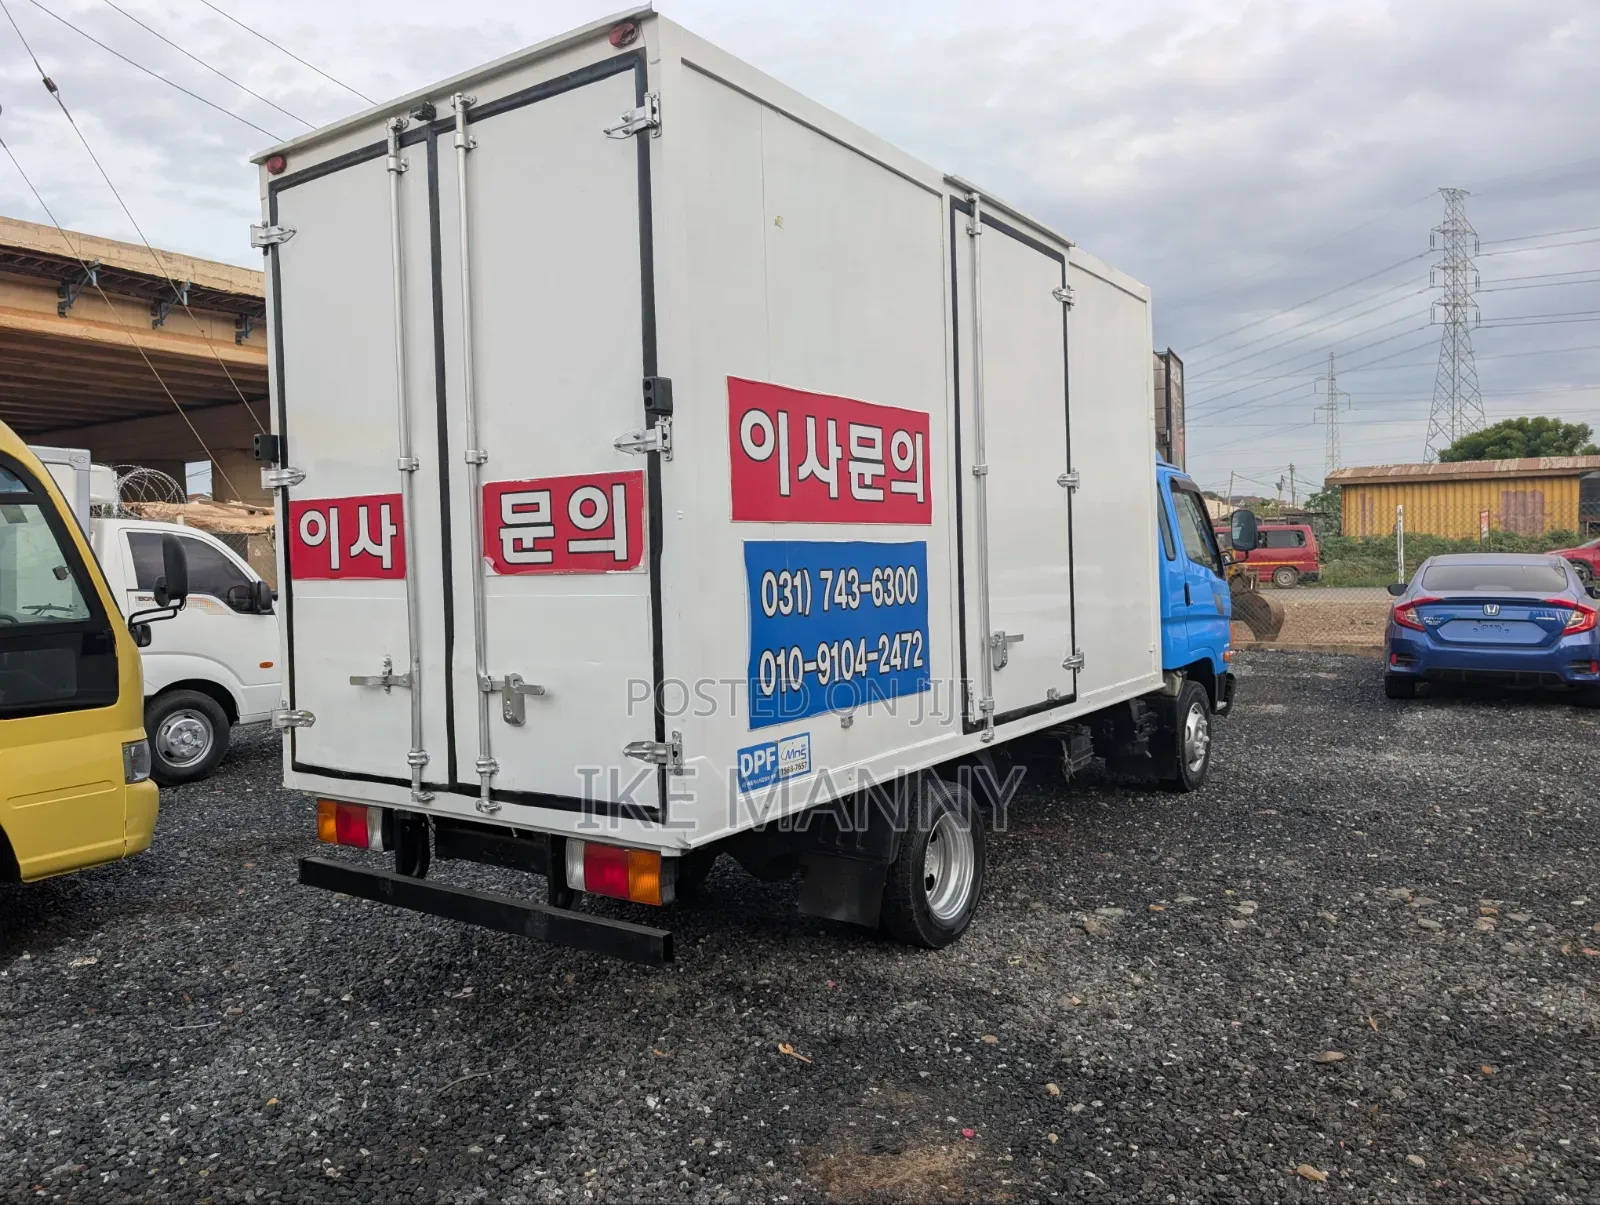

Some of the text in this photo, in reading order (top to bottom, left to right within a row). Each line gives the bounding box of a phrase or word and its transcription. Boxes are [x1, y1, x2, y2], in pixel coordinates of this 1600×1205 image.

[739, 408, 924, 503] 이사문의
[299, 483, 628, 570] 이사 문의
[761, 565, 919, 618] 031) 743-6300
[759, 629, 923, 697] 010-9104-2472
[740, 746, 776, 778] DPF
